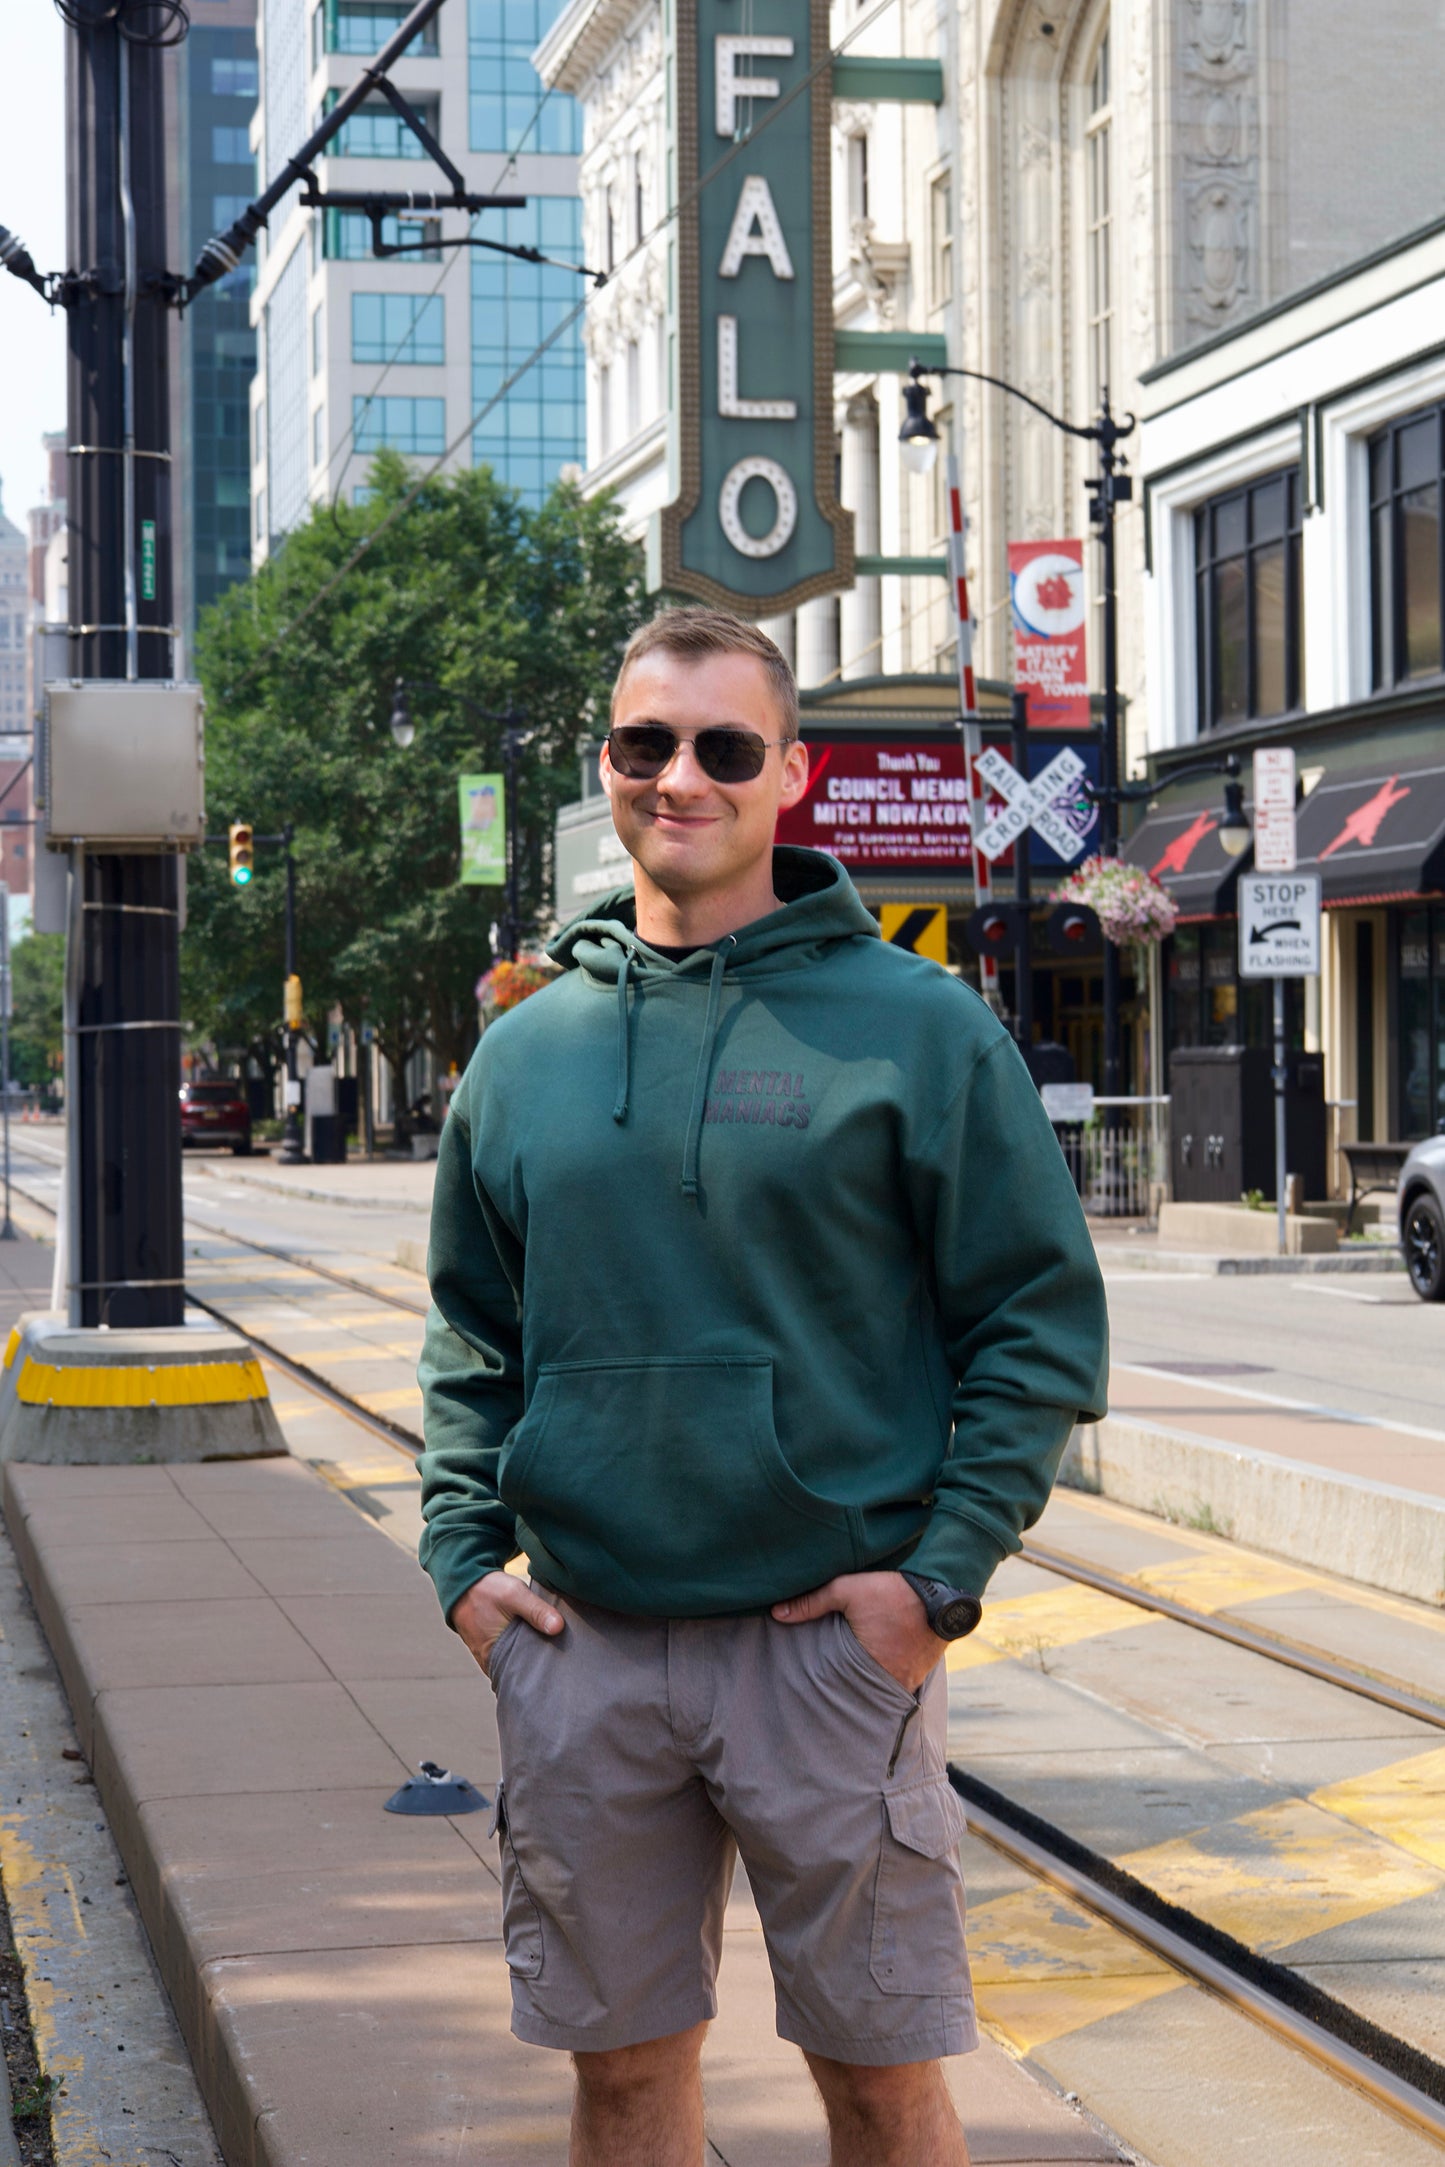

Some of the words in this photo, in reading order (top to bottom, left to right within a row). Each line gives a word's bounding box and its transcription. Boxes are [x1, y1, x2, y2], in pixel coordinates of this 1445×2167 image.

[1015, 645, 1078, 659] SATISFY
[1042, 658, 1071, 671] ALL
[1014, 671, 1065, 684] DOWN
[1041, 683, 1089, 697] TOWN
[828, 778, 905, 800] COUNCIL
[911, 778, 968, 800] MEMB
[982, 755, 1019, 797] RAIL
[1038, 809, 1078, 854] ROAD
[985, 759, 1075, 850] CROSSING
[814, 803, 871, 824] MITCH
[1253, 884, 1307, 903] STOP
[1262, 906, 1295, 918] HERE
[1275, 938, 1310, 949] WHEN
[1250, 954, 1311, 967] FLASHING
[714, 1069, 806, 1098] MENTAL
[705, 1099, 811, 1129] MANIACS
